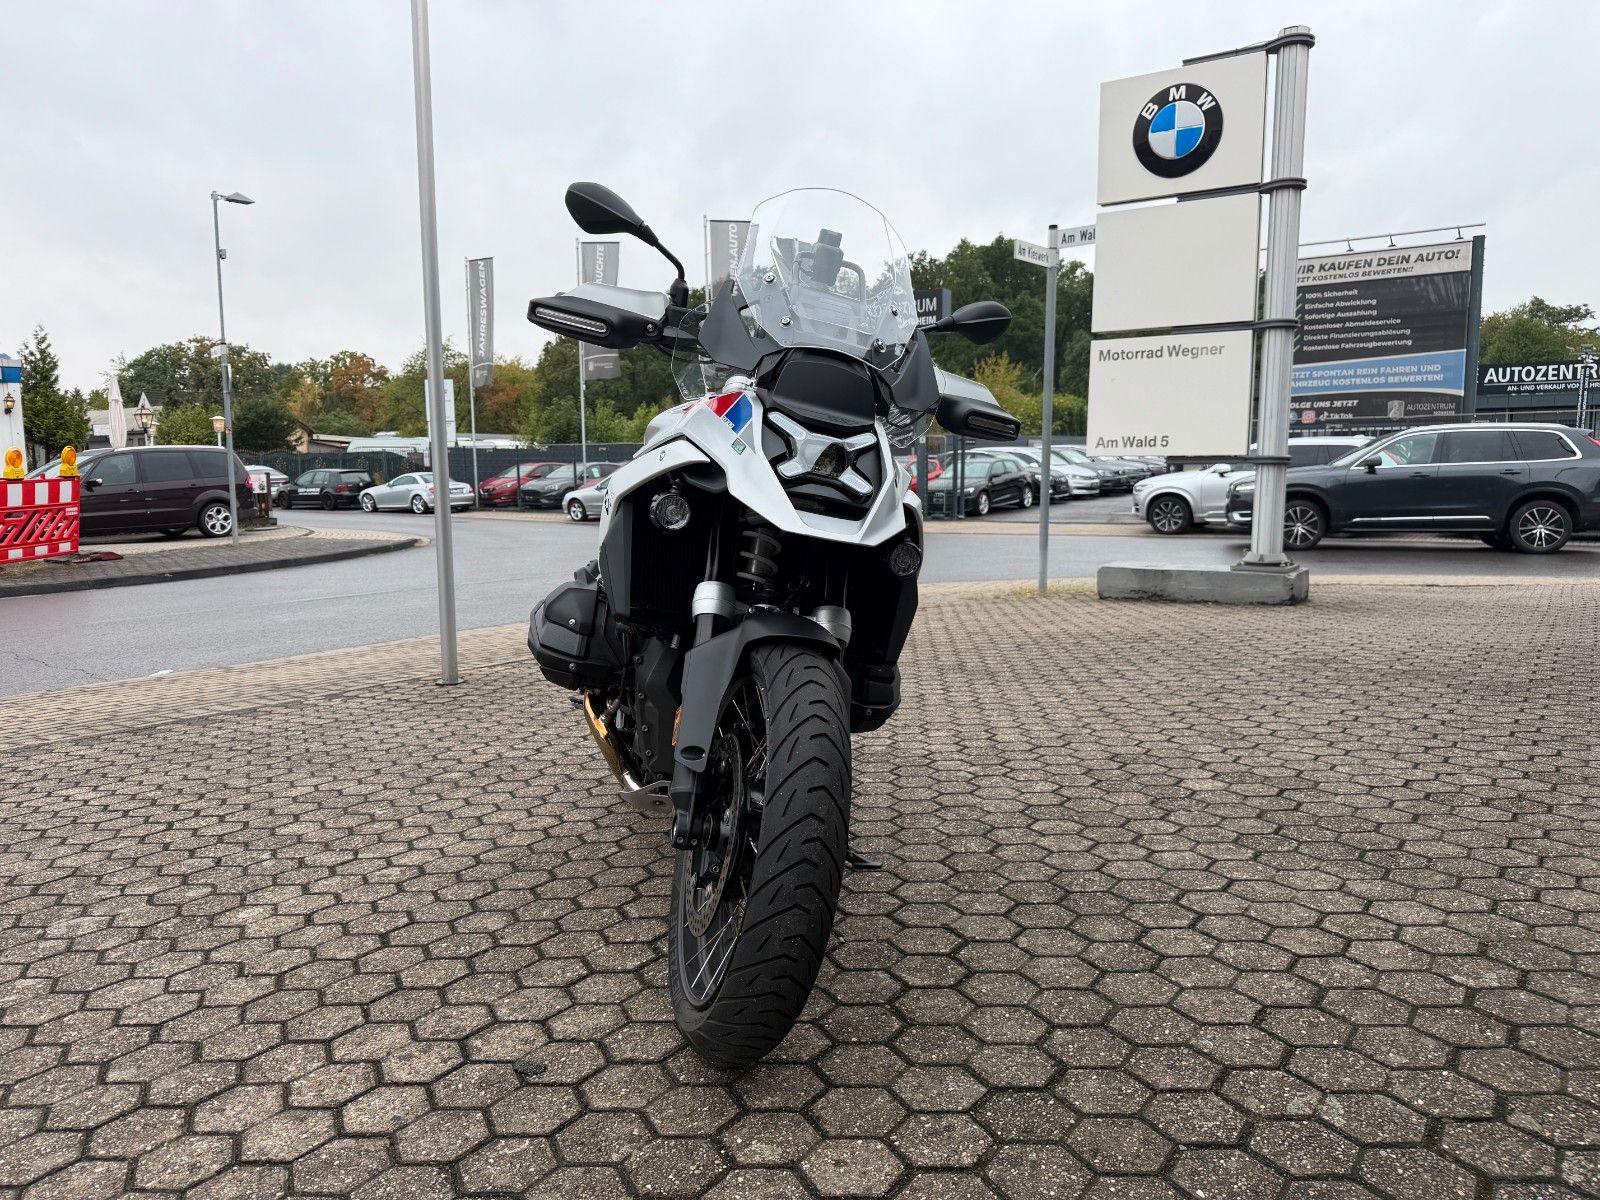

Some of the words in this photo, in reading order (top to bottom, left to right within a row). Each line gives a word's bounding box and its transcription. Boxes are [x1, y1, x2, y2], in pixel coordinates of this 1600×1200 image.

[1141, 85, 1216, 120] BMW
[1061, 233, 1075, 244] Am
[1080, 228, 1096, 241] Wal
[1018, 244, 1026, 256] Am
[1318, 258, 1373, 272] KAUFEN
[1376, 254, 1411, 267] DEIN
[1414, 249, 1461, 263] AUTO!
[1312, 271, 1359, 282] KOSTENLOS
[1361, 266, 1414, 277] BEWERTEN!!
[1323, 289, 1358, 298] Sicherheit
[478, 260, 487, 357] JAHRESWAGEN
[1305, 302, 1334, 310] Einfache
[1335, 299, 1377, 307] Abwicklung
[1304, 312, 1335, 320] Sofortige
[1336, 309, 1377, 318] Auszahlung
[1303, 323, 1343, 331] Kostenloser
[1329, 329, 1411, 340] Finanzierungsablösung
[1303, 344, 1339, 352] Kostenlose
[1341, 339, 1412, 349] Fahrzeugbewertung
[1098, 346, 1164, 361] Motorrad
[1166, 344, 1225, 359] Wegner
[1312, 369, 1354, 378] SPONTAN
[1356, 367, 1378, 375] REIN
[1380, 365, 1418, 374] FAHREN
[1420, 364, 1441, 372] UND
[1484, 363, 1600, 383] AUTOZENTR
[1332, 376, 1386, 386] KOSTENLOS
[1388, 374, 1444, 384] BEWERTEN!
[1407, 402, 1456, 411] AUTOZENTRUM
[1095, 437, 1119, 448] Am
[1121, 435, 1157, 448] Wald
[1160, 435, 1170, 448] 5
